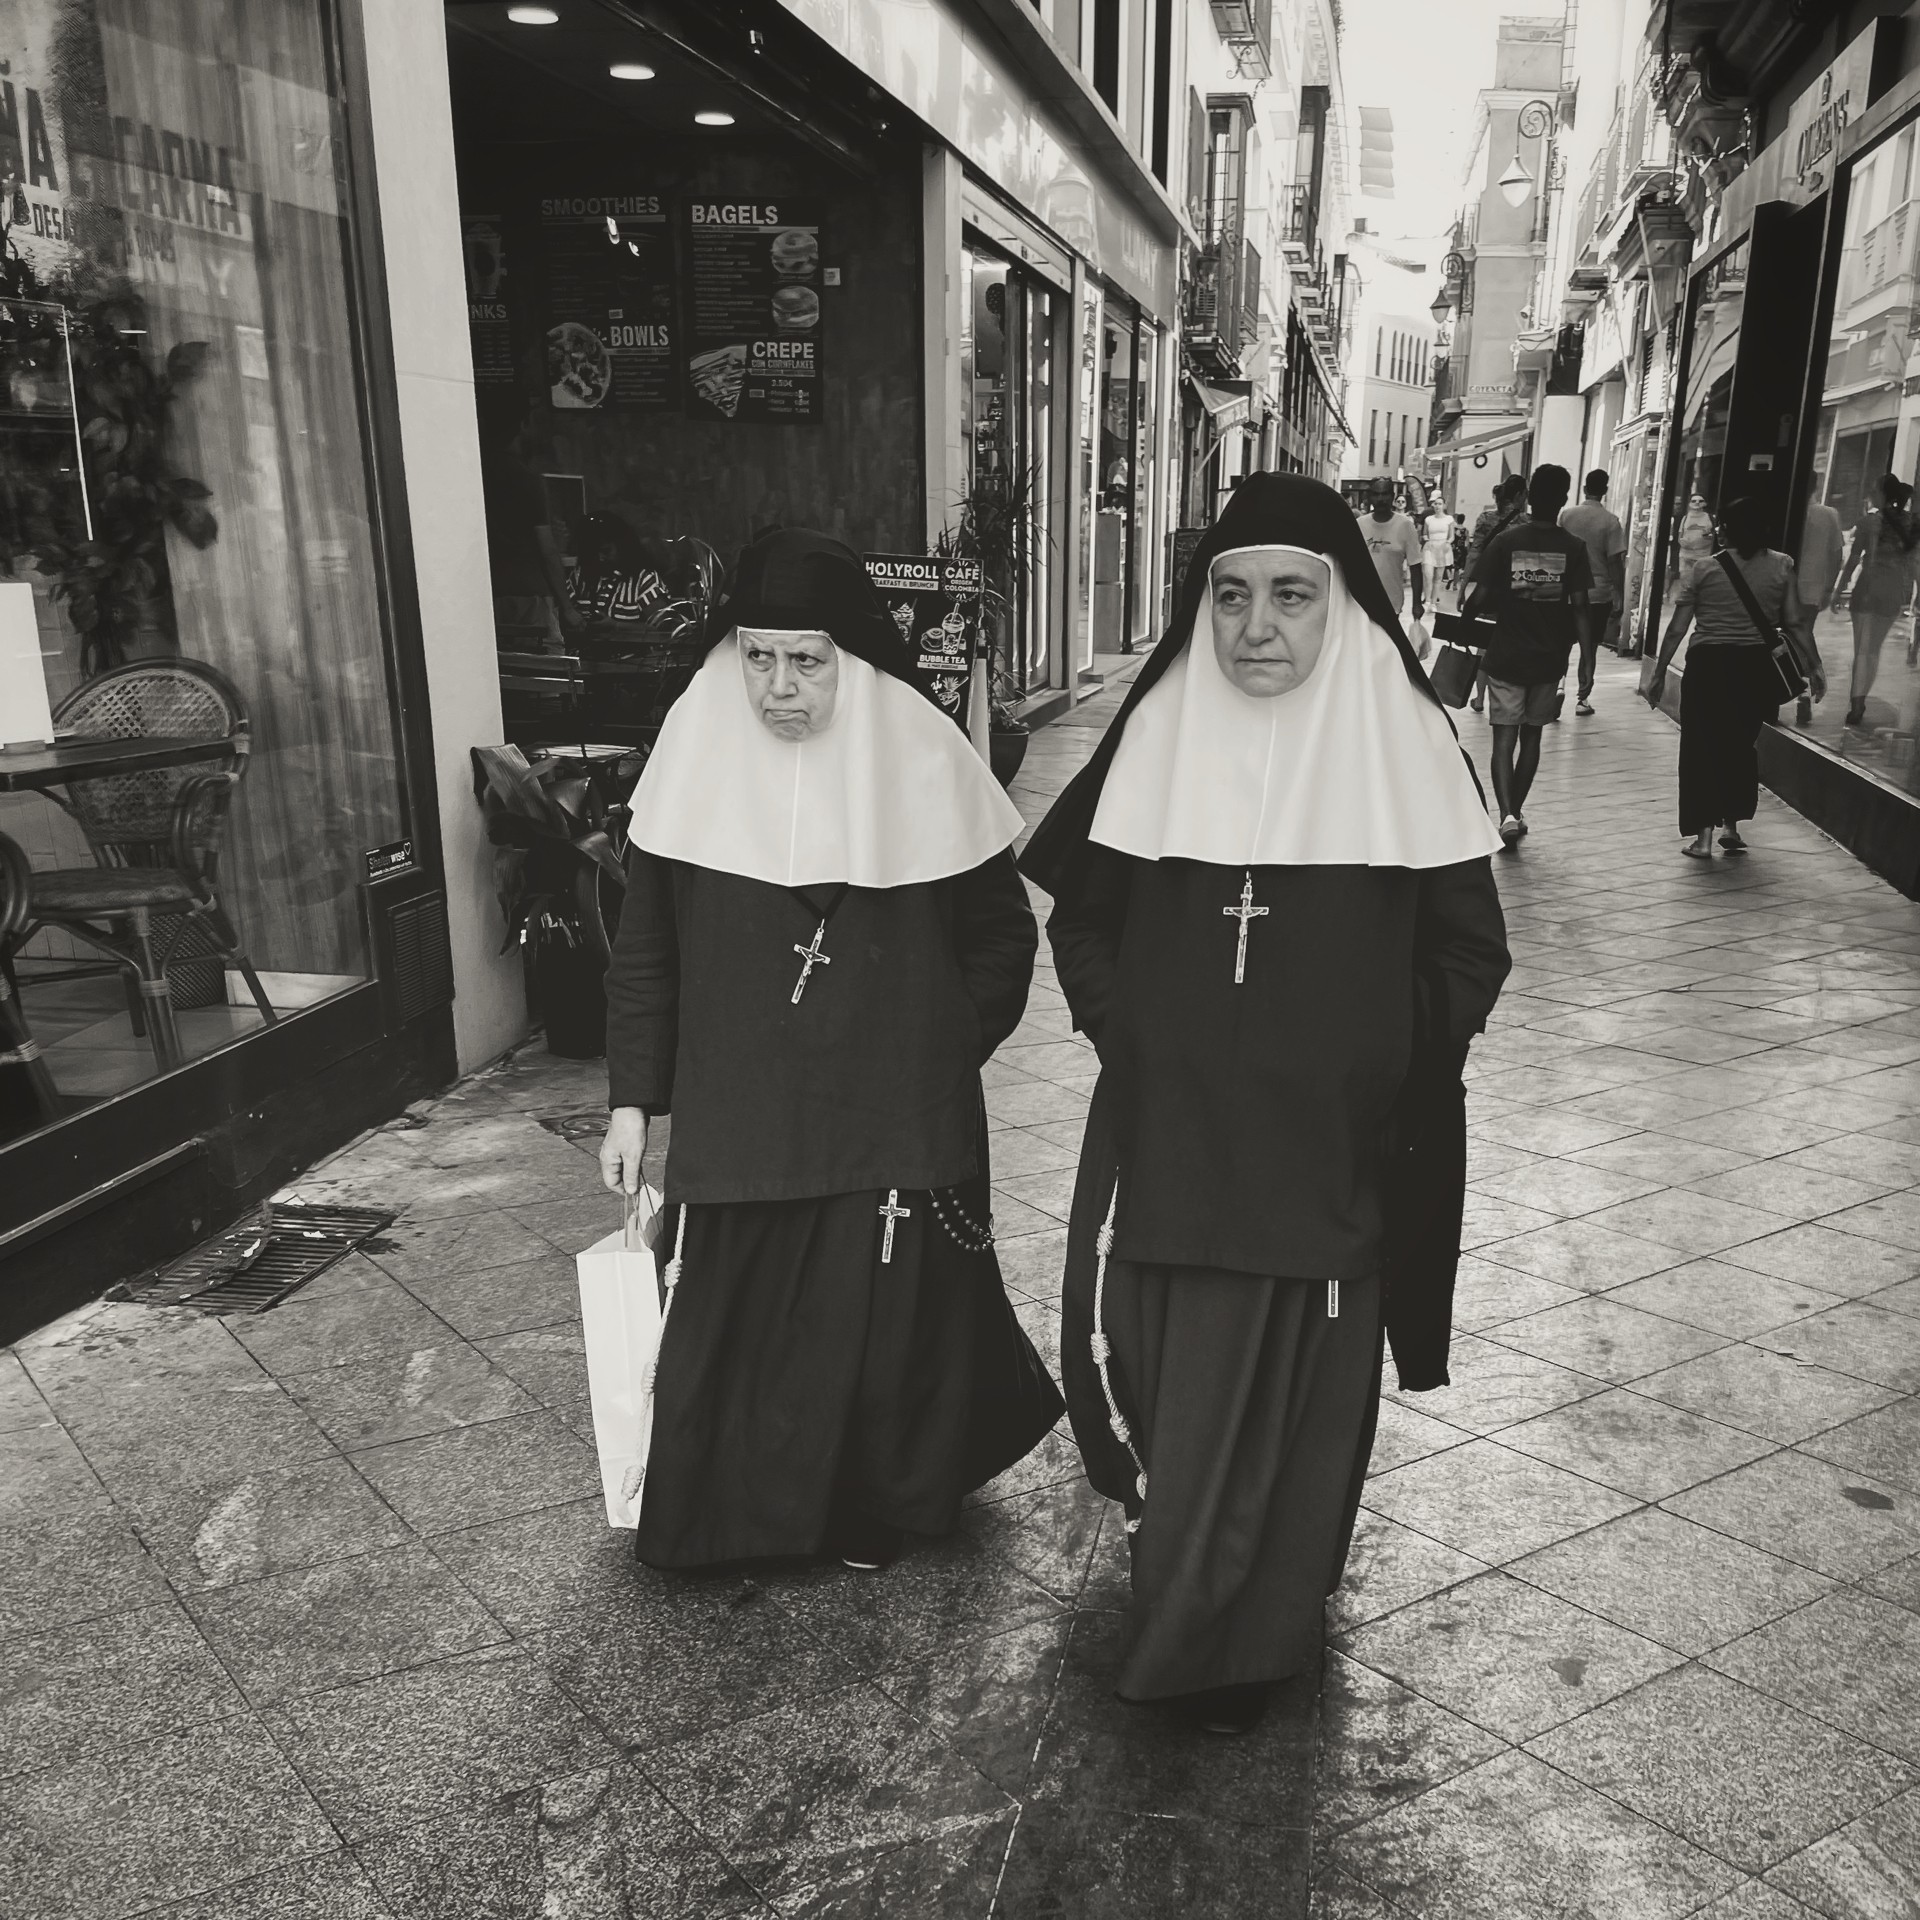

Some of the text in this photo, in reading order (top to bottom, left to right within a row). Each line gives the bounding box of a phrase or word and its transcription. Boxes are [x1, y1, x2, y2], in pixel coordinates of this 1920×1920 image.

[541, 196, 660, 216] SMOOTHIES
[691, 205, 779, 225] BAGELS
[752, 341, 814, 359] CREPE
[752, 359, 814, 370] CON CORNFLAKES
[865, 562, 939, 579] HOLYROLL
[1522, 571, 1561, 582] Columbia
[909, 581, 935, 589] BRUNCH
[944, 585, 979, 593] COLOMBIA
[919, 654, 966, 665] BUBBLE TEA
